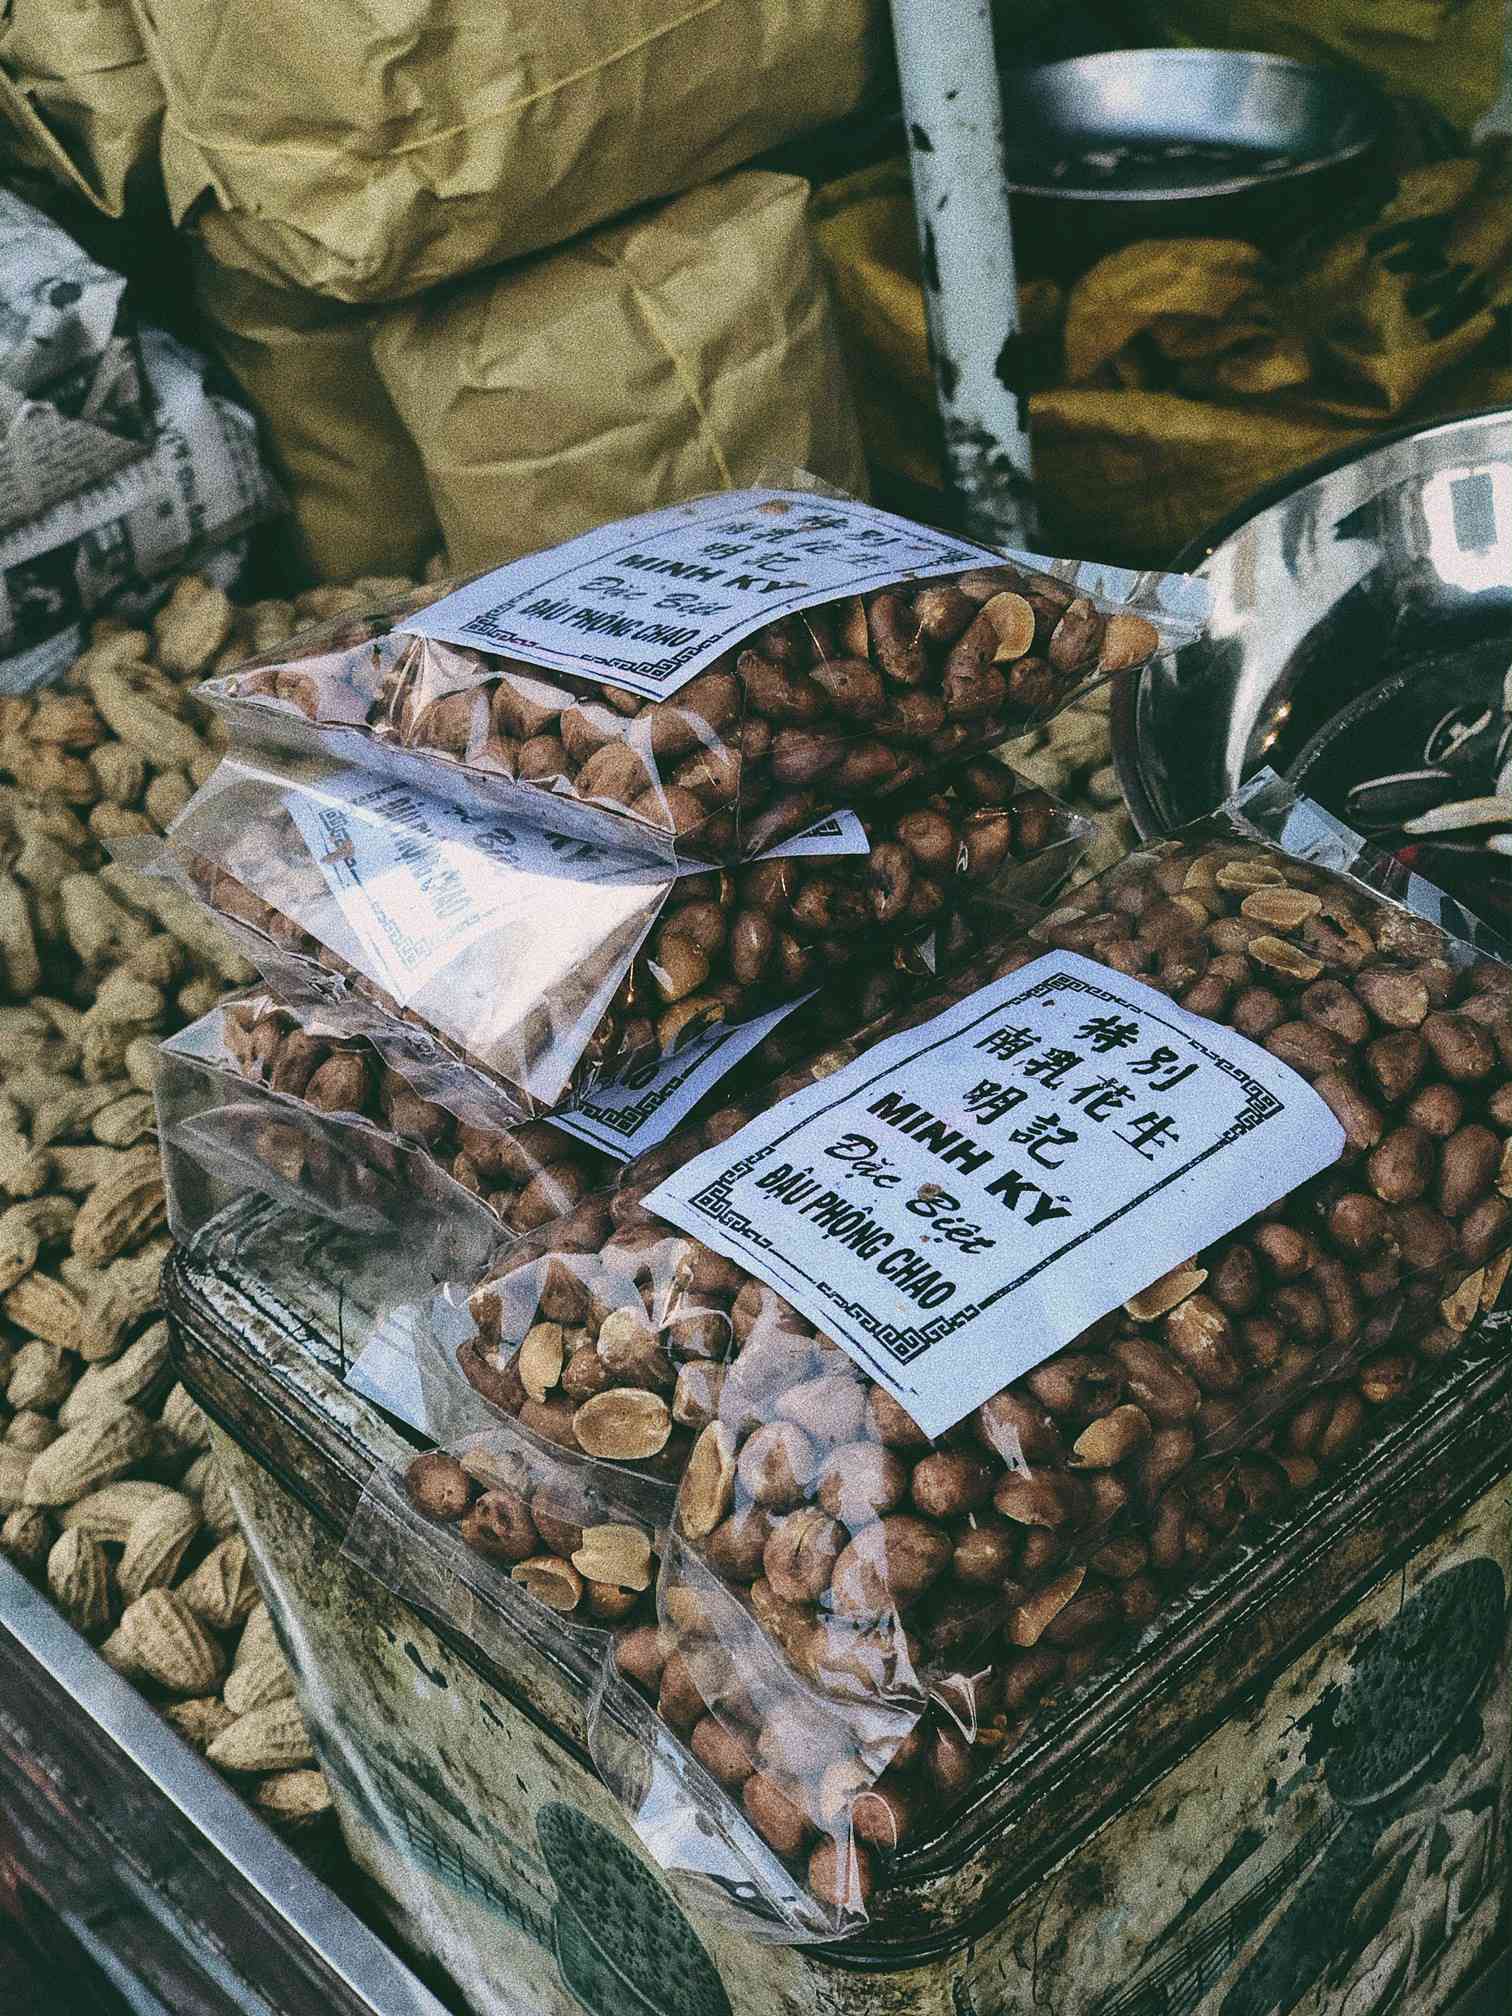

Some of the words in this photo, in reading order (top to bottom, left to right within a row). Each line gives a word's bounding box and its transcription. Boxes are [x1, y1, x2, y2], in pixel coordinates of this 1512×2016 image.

[616, 554, 727, 583] MINH
[630, 624, 701, 648] CHAO
[973, 1024, 1180, 1160] 南乳花生
[1073, 1015, 1200, 1091] 特別
[866, 1091, 995, 1175] MINH
[962, 1078, 1079, 1169] 明記
[755, 1163, 822, 1205] ĐẬU
[876, 1248, 956, 1309] CHAO
[823, 1133, 902, 1189] Đặc
[905, 1186, 996, 1254] Biệt
